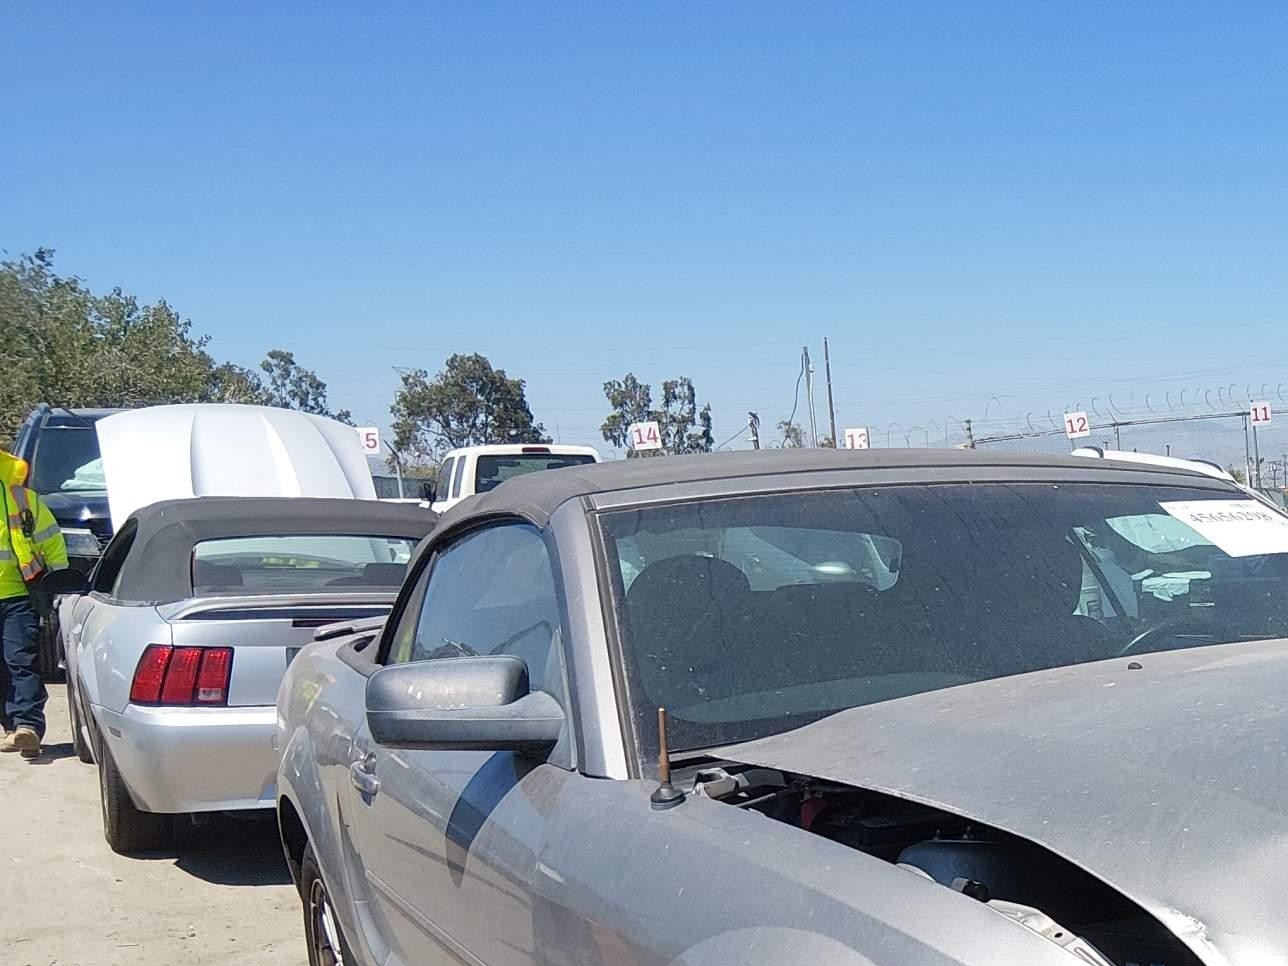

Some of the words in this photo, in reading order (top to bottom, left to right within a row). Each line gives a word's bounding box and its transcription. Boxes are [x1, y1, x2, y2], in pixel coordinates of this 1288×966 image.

[1252, 406, 1271, 422] 11
[1066, 416, 1088, 434] 12
[362, 432, 378, 450] 5
[634, 426, 659, 445] 14
